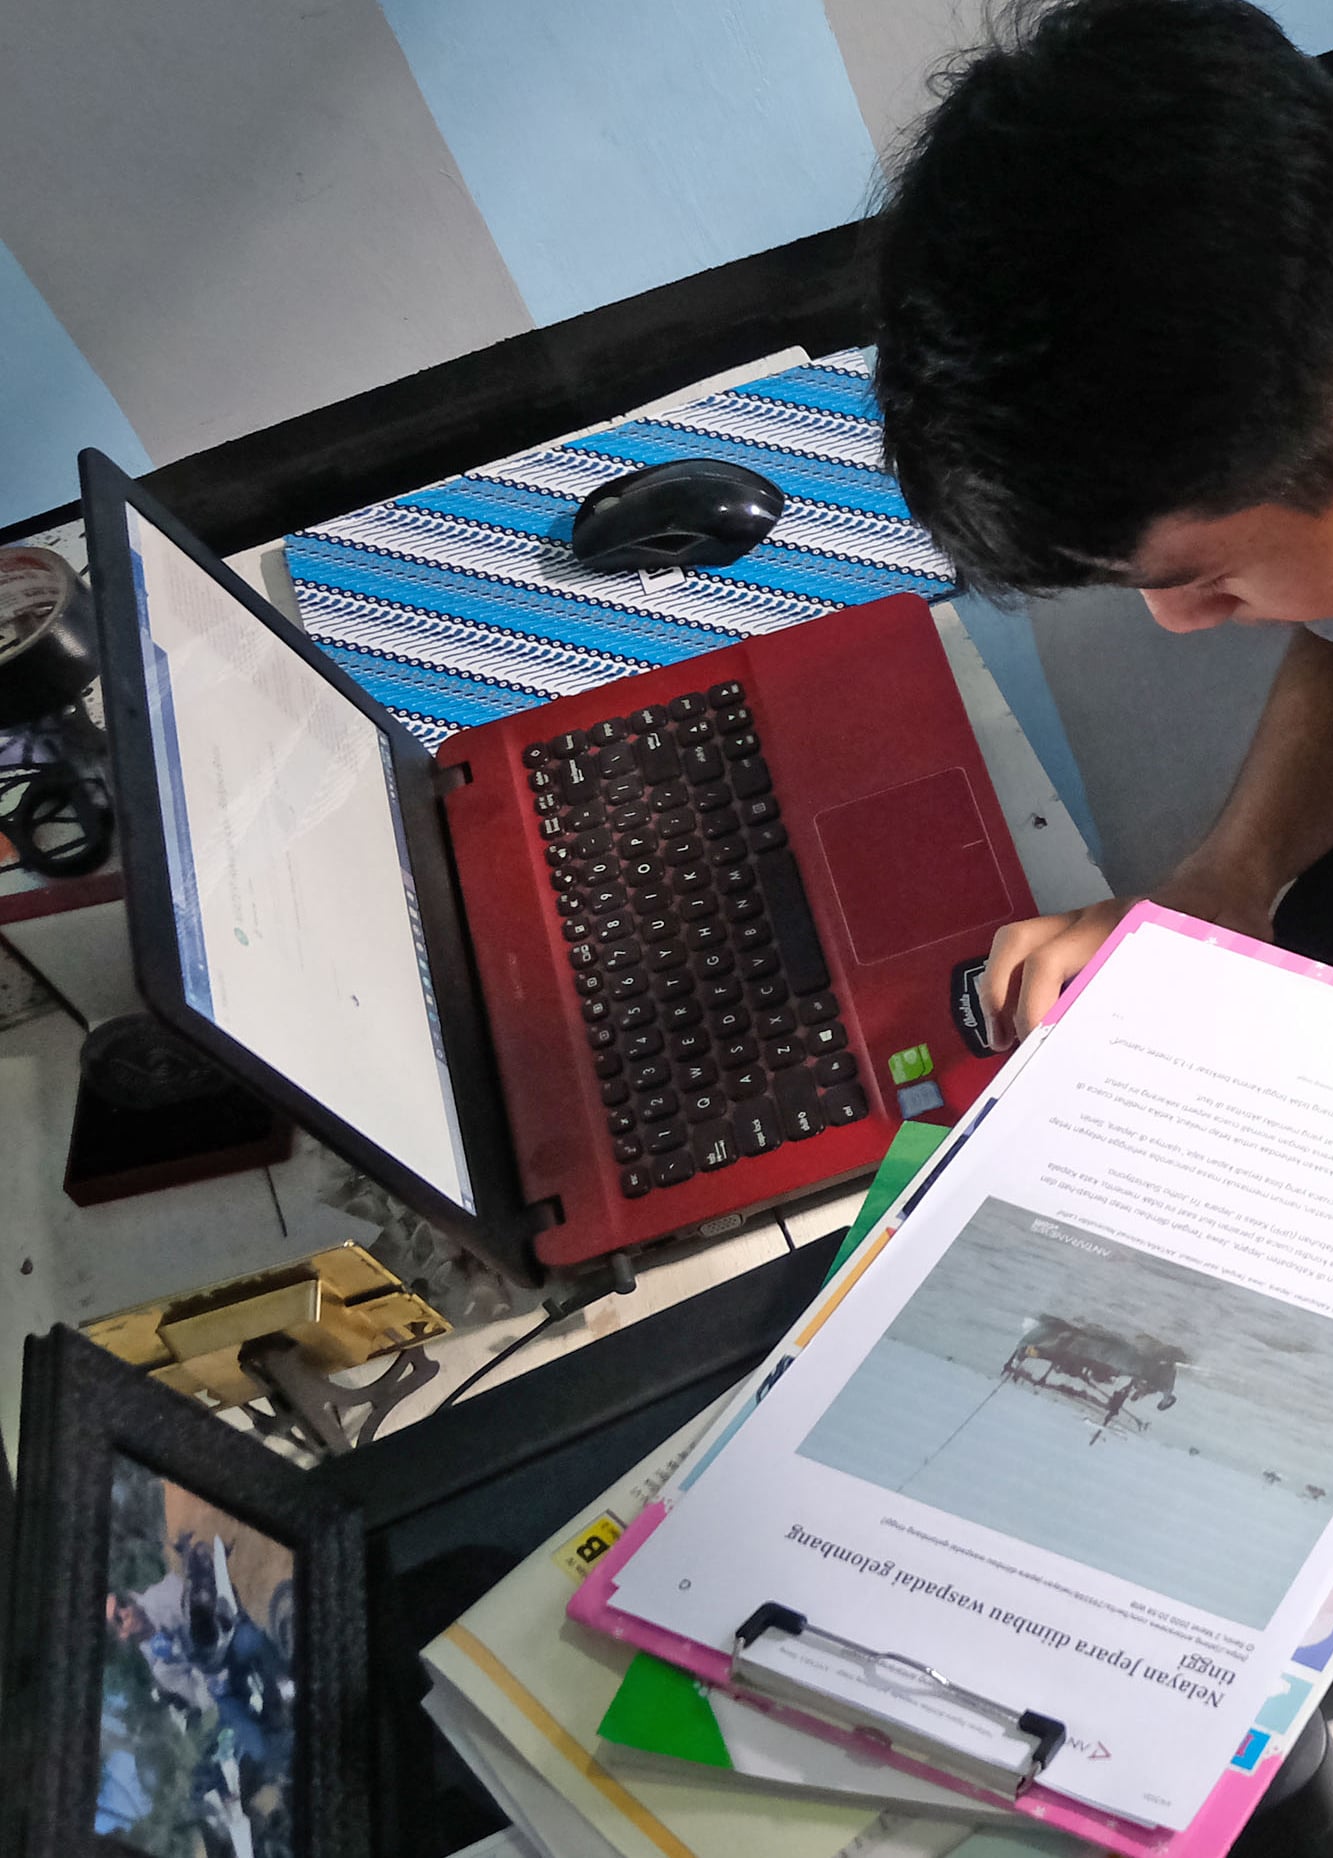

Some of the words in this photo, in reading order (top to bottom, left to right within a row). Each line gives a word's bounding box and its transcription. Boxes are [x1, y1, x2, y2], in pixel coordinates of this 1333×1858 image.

[638, 864, 650, 873] O
[684, 872, 696, 880] K
[729, 871, 741, 880] M
[737, 900, 748, 908] N
[607, 920, 619, 928] 8
[652, 921, 664, 929] U
[699, 928, 711, 936] H
[745, 928, 757, 936] B
[707, 956, 719, 965] G
[760, 987, 773, 995] C
[723, 1015, 735, 1024] D
[770, 1016, 782, 1024] X
[634, 1036, 647, 1044] 4
[777, 1046, 790, 1054] Z
[690, 1068, 702, 1078] W
[650, 1098, 663, 1106] 2
[697, 1098, 710, 1108] Q
[1032, 1223, 1111, 1254] ANTARANEWS
[576, 1534, 610, 1563] B
[784, 1524, 895, 1576] gelombang
[891, 1569, 984, 1614] waspadai
[988, 1606, 1070, 1648] diimbau
[1074, 1639, 1143, 1676] Jepara
[1176, 1653, 1235, 1685] tinggi
[1143, 1665, 1223, 1707] Nelayan
